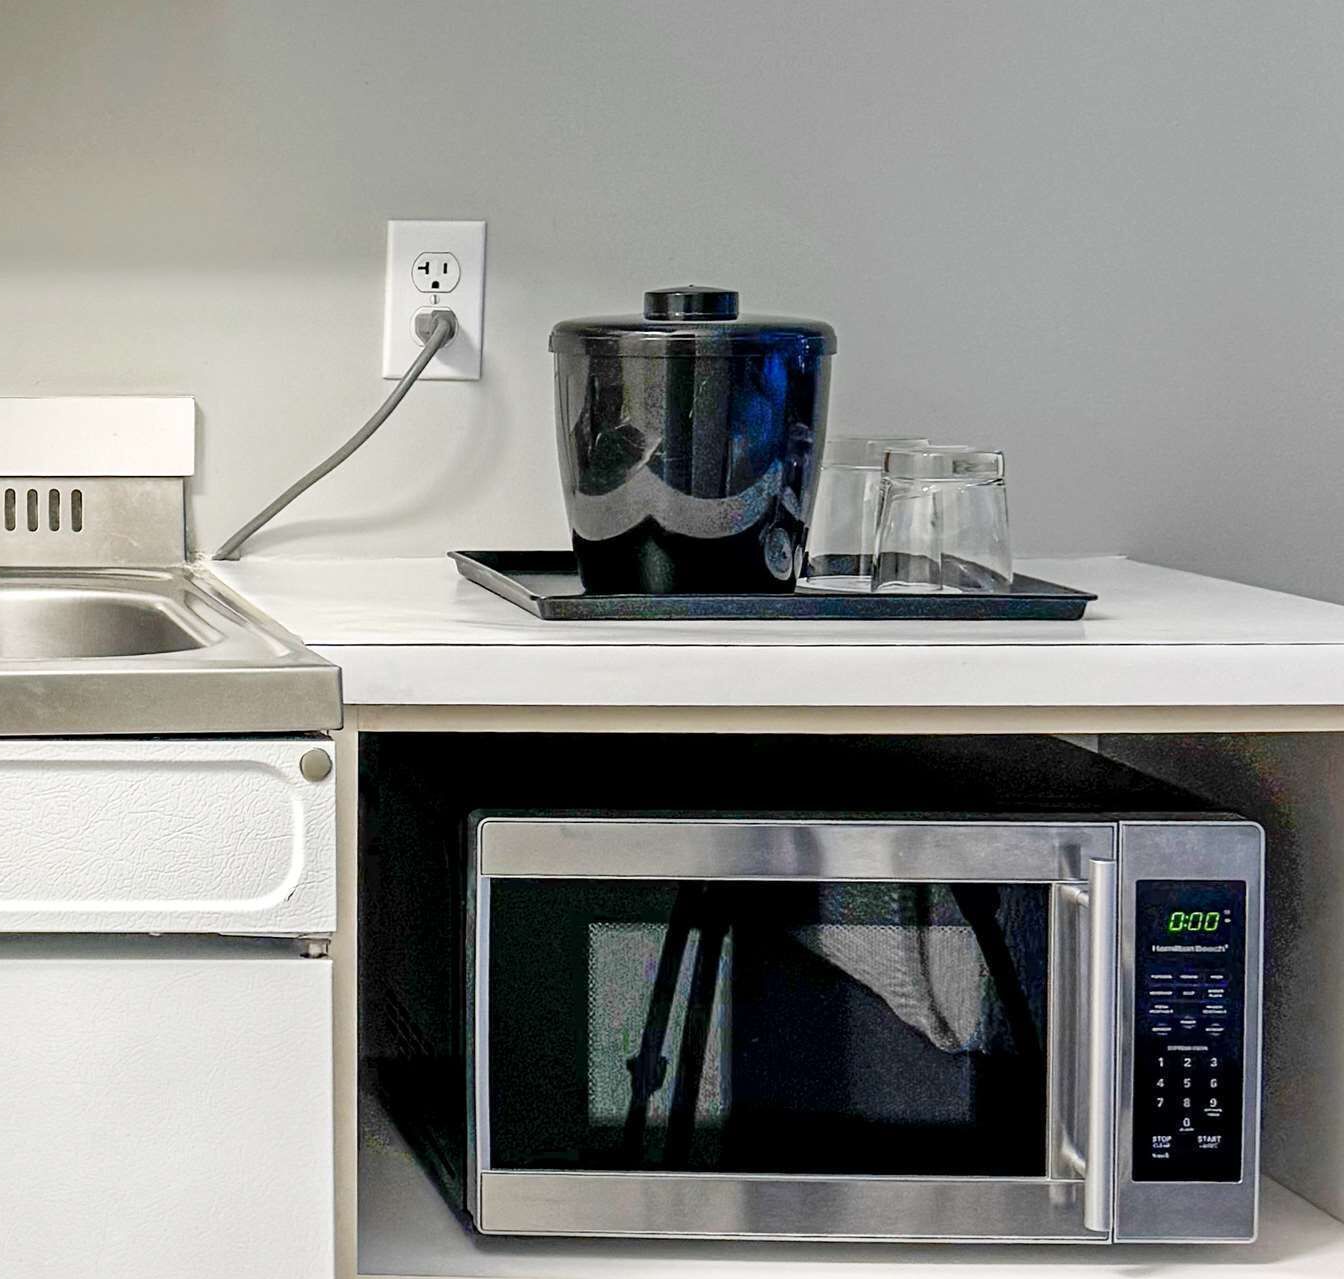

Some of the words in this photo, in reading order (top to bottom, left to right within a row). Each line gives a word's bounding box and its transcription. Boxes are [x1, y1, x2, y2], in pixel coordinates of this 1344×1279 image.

[1169, 911, 1220, 931] 0:00
[1158, 1057, 1164, 1067] 1
[1183, 1057, 1192, 1067] 2
[1210, 1057, 1217, 1067] 3
[1156, 1078, 1165, 1088] 4
[1183, 1078, 1191, 1088] 5
[1156, 1097, 1164, 1108] 7
[1183, 1097, 1191, 1108] 8
[1209, 1097, 1217, 1108] 9
[1182, 1117, 1191, 1127] 0
[1152, 1135, 1172, 1143] STOP
[1197, 1135, 1222, 1143] START
